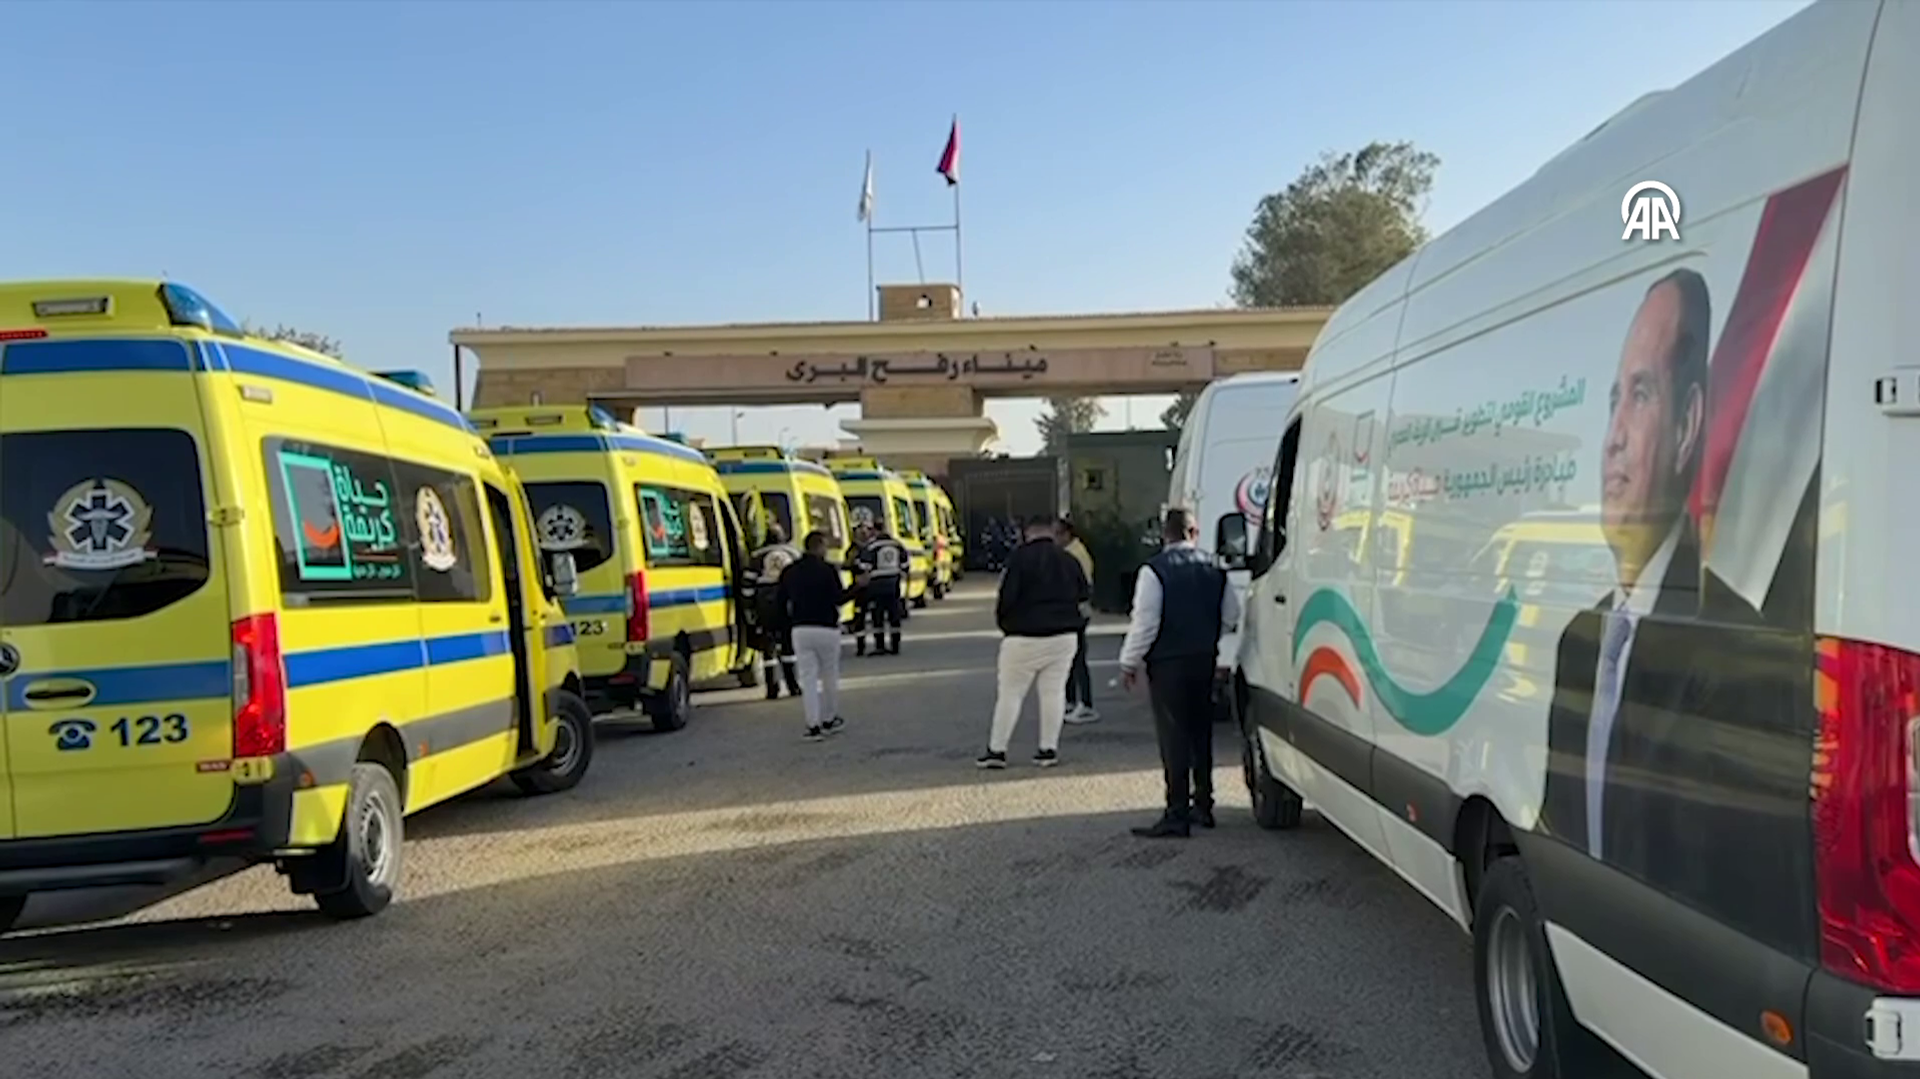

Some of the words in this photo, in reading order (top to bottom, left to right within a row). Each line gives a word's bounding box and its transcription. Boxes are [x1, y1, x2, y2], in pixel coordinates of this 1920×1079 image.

[871, 352, 959, 384] رفح
[962, 352, 1048, 379] ميناء
[334, 464, 389, 514] حياة
[343, 504, 396, 551] كريمة
[569, 620, 604, 636] 123
[110, 713, 188, 747] 123
